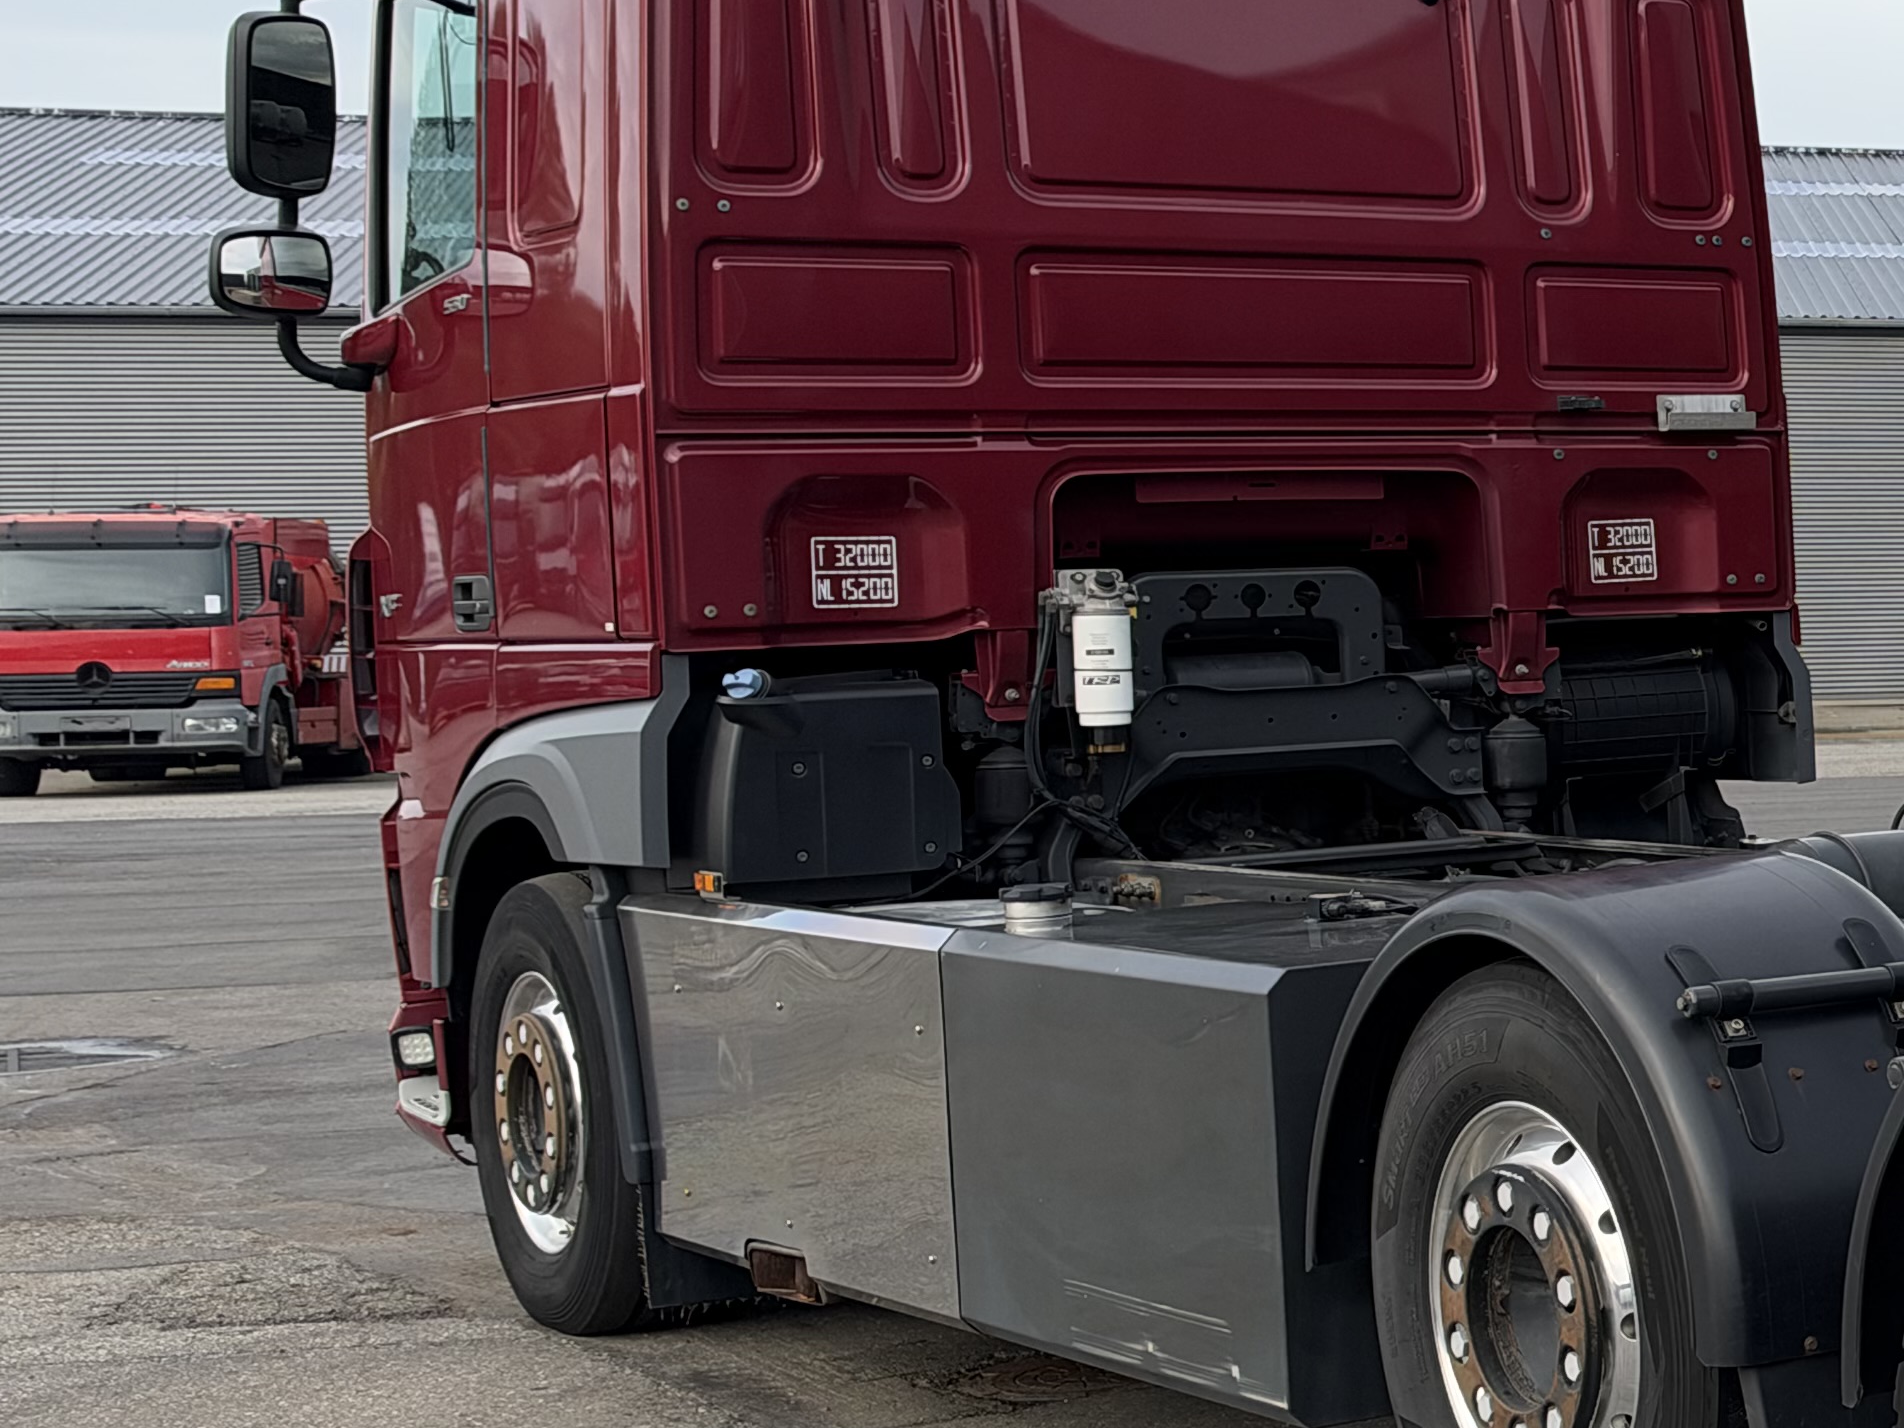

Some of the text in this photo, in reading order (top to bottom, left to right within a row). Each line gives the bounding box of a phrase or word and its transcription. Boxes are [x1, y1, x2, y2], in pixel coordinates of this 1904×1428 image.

[1592, 525, 1651, 547] T 32000
[816, 543, 892, 567] T 32000
[1593, 554, 1653, 577] NL 15200
[817, 577, 893, 600] NL 15200
[1431, 1027, 1489, 1083] AH51
